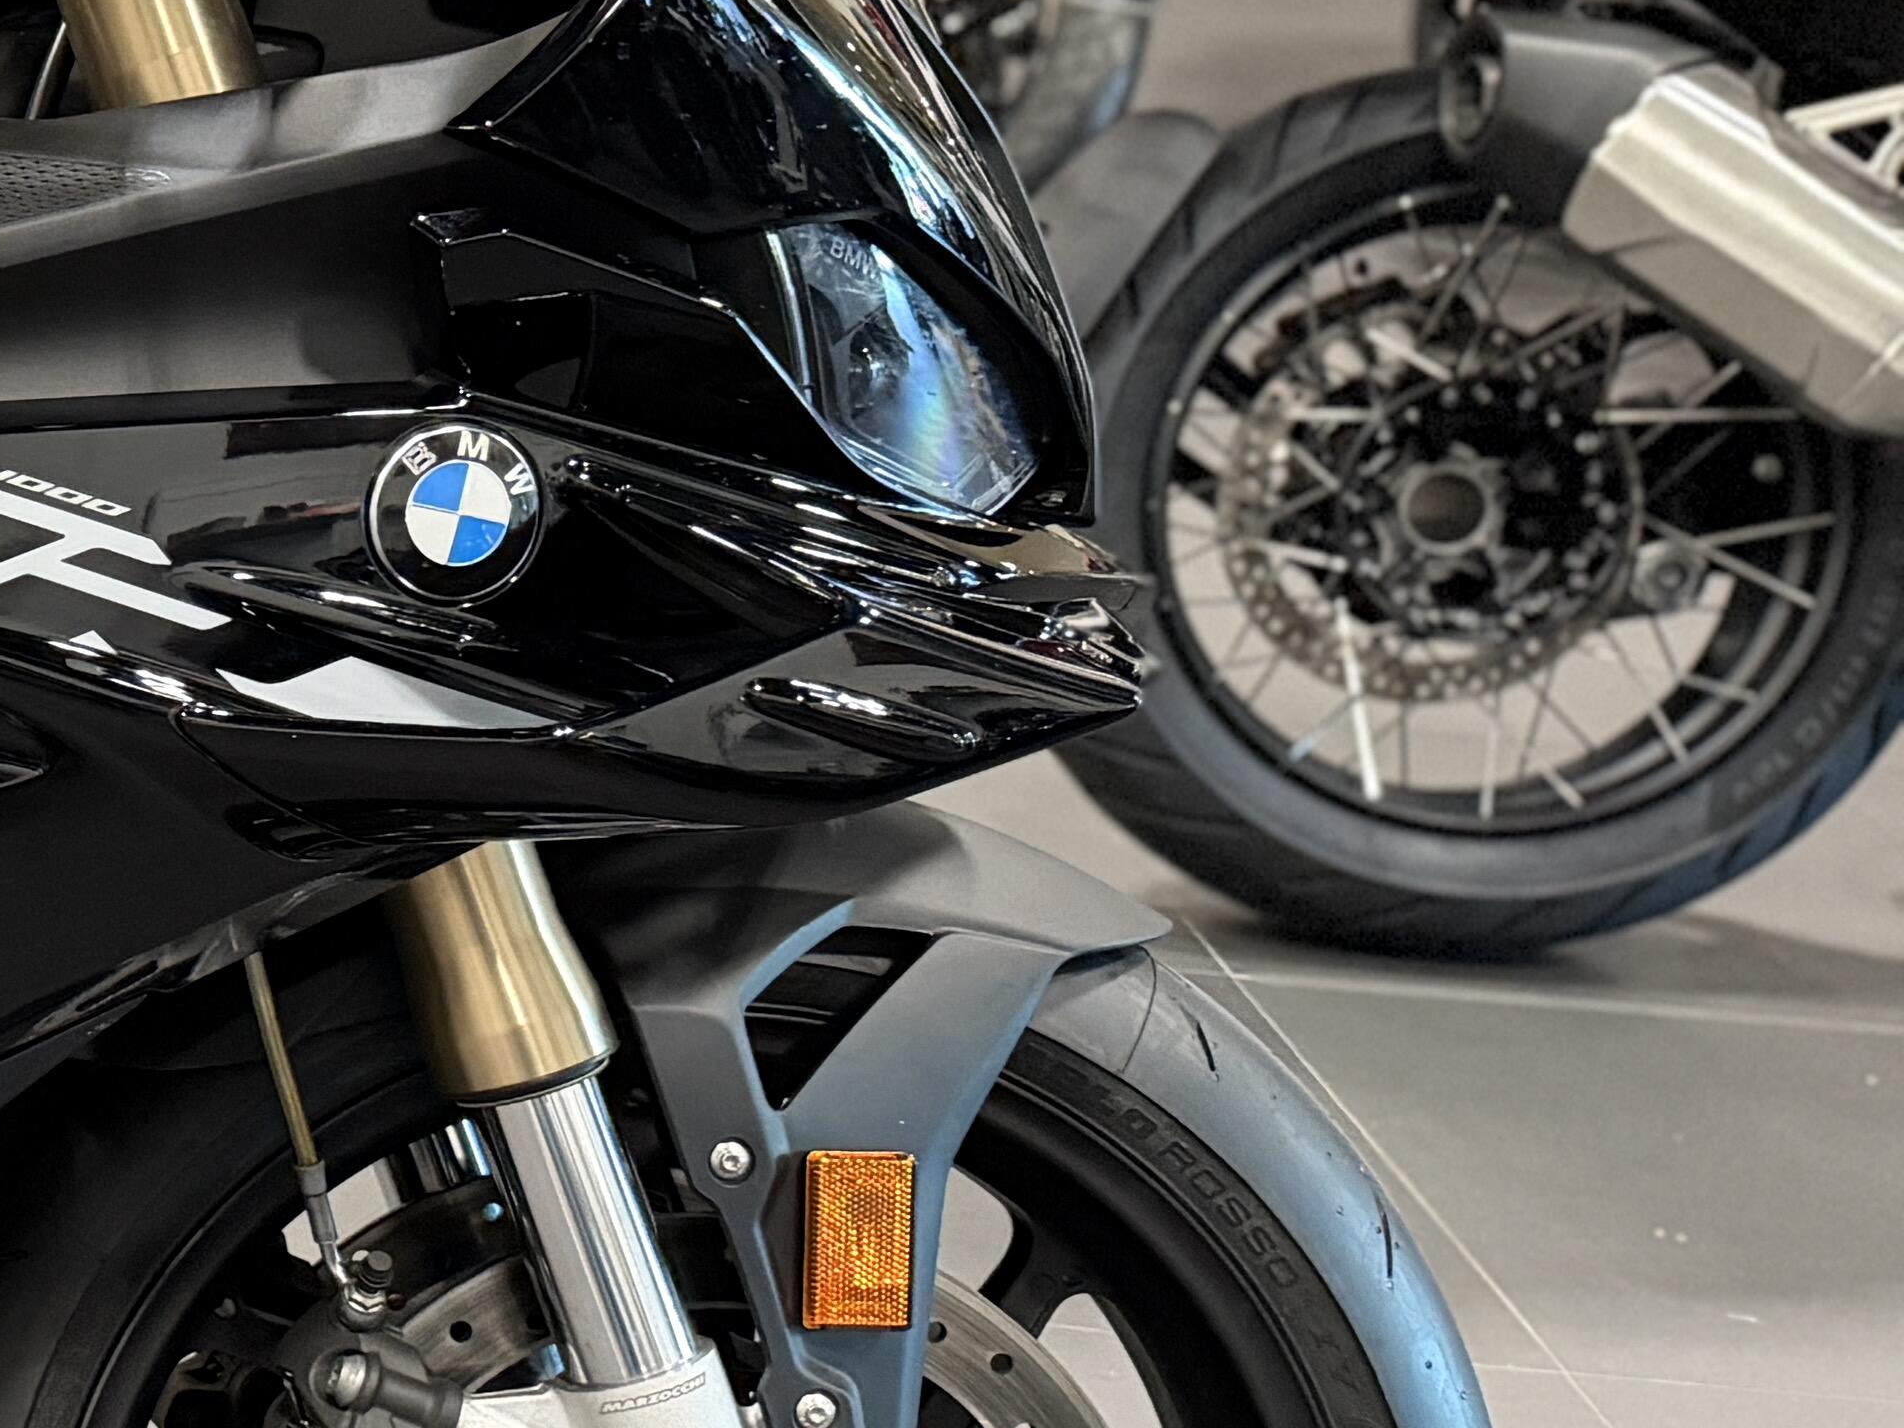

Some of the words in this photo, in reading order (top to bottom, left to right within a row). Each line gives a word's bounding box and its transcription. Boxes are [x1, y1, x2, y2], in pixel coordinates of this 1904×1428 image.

[830, 235, 878, 280] BMW
[401, 430, 536, 496] BMW
[1158, 1138, 1297, 1289] ROSSO
[599, 1372, 706, 1415] MARZOCCHI
